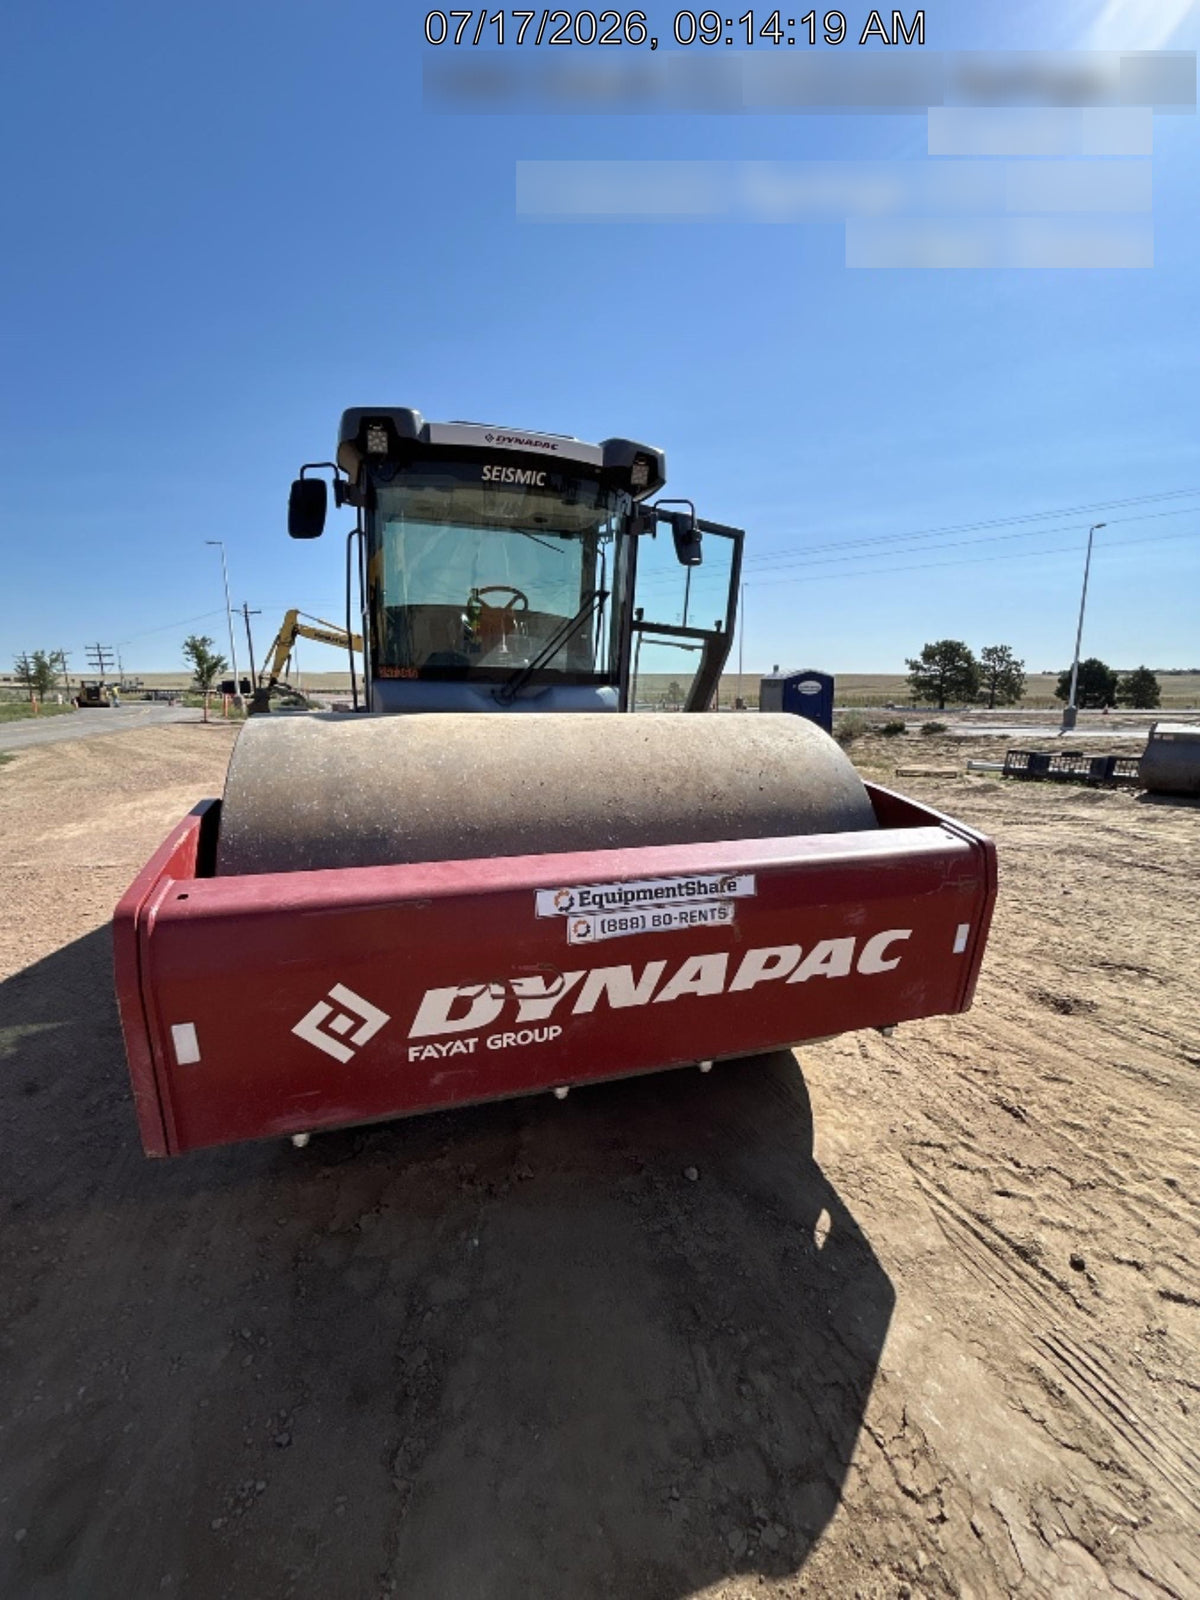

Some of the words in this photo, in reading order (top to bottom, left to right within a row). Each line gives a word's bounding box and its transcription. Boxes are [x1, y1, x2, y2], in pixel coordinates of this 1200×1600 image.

[496, 435, 559, 450] DYNAPAC
[481, 465, 547, 486] SEISMIC
[579, 880, 737, 908] EquipmentShare
[600, 915, 646, 934] (888)
[408, 929, 912, 1038] DYNAPAC
[408, 1037, 478, 1063] FAYAT
[486, 1025, 563, 1050] GROUP
